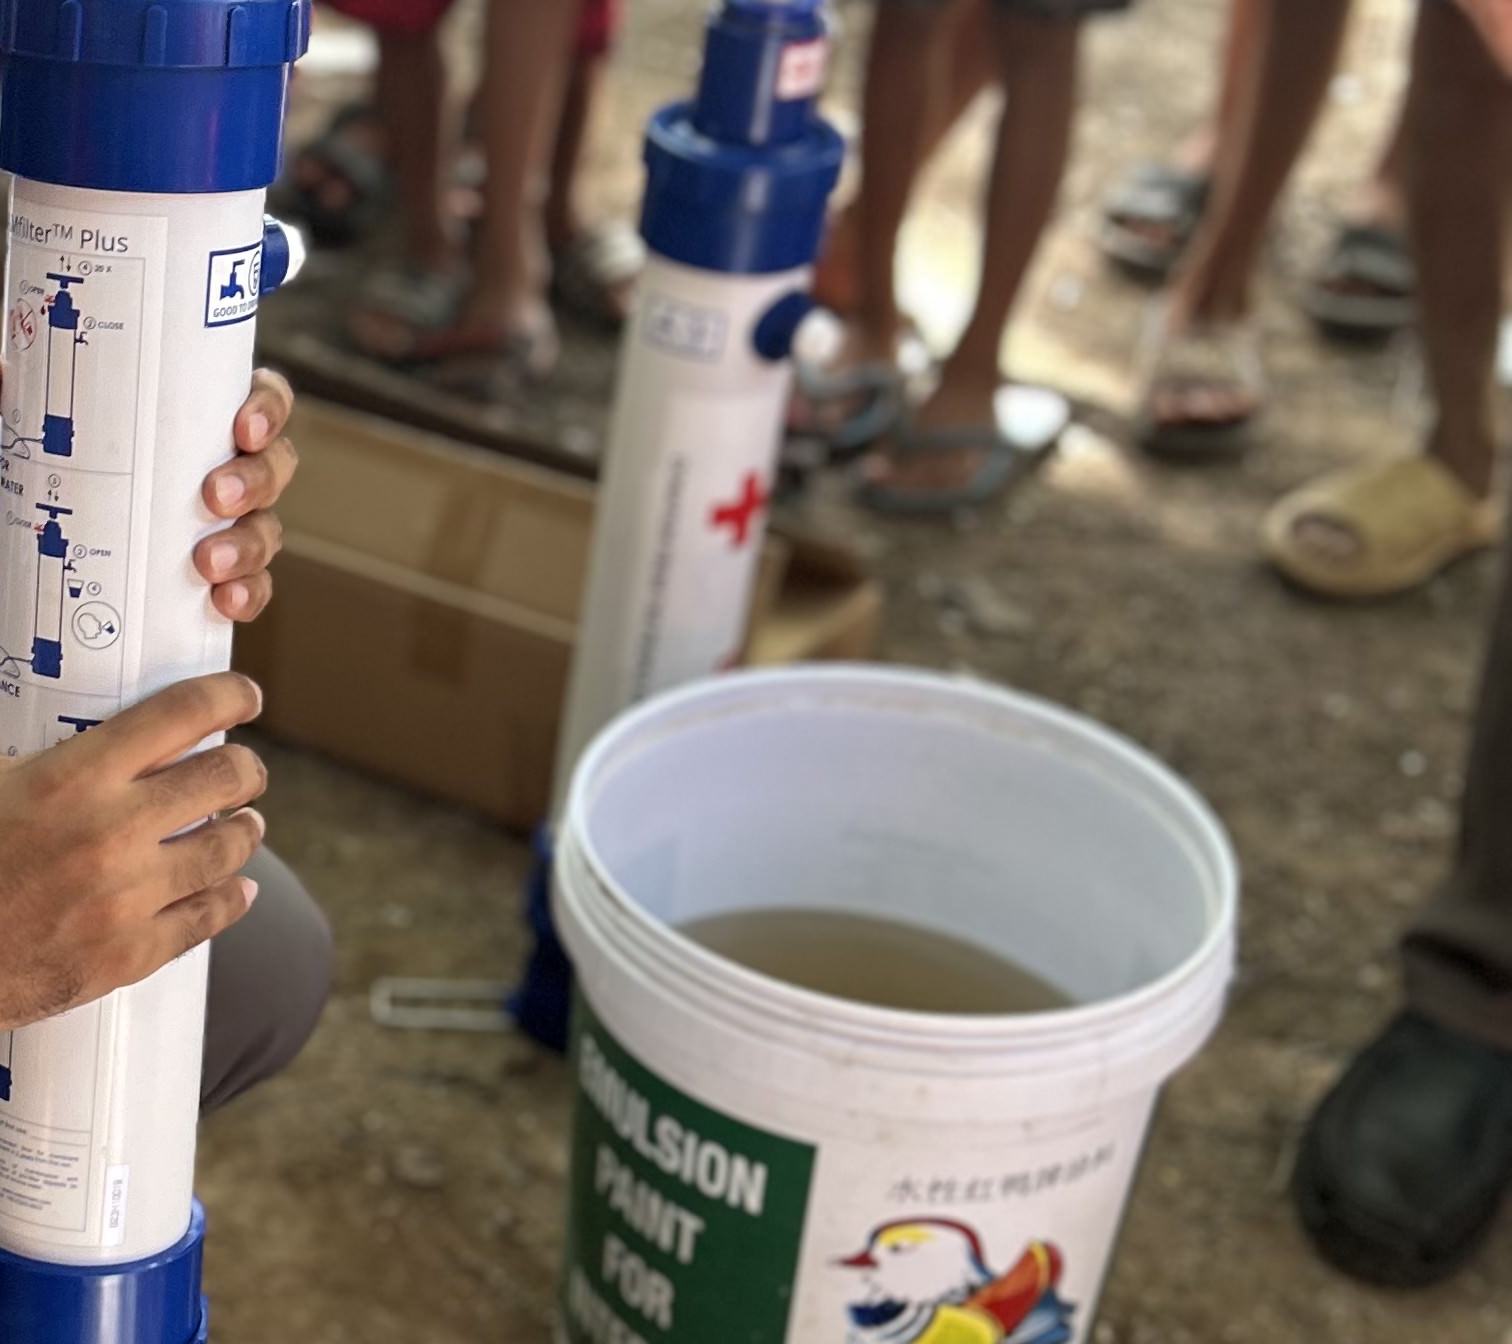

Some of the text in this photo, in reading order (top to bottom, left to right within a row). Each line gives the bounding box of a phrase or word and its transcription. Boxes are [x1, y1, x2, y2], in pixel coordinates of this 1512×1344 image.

[80, 229, 129, 253] Plus
[213, 304, 238, 317] GOOD
[98, 321, 124, 330] CLOSE
[89, 548, 111, 557] OPEN
[595, 1142, 705, 1266] PAINT
[601, 1232, 676, 1332] FOR
